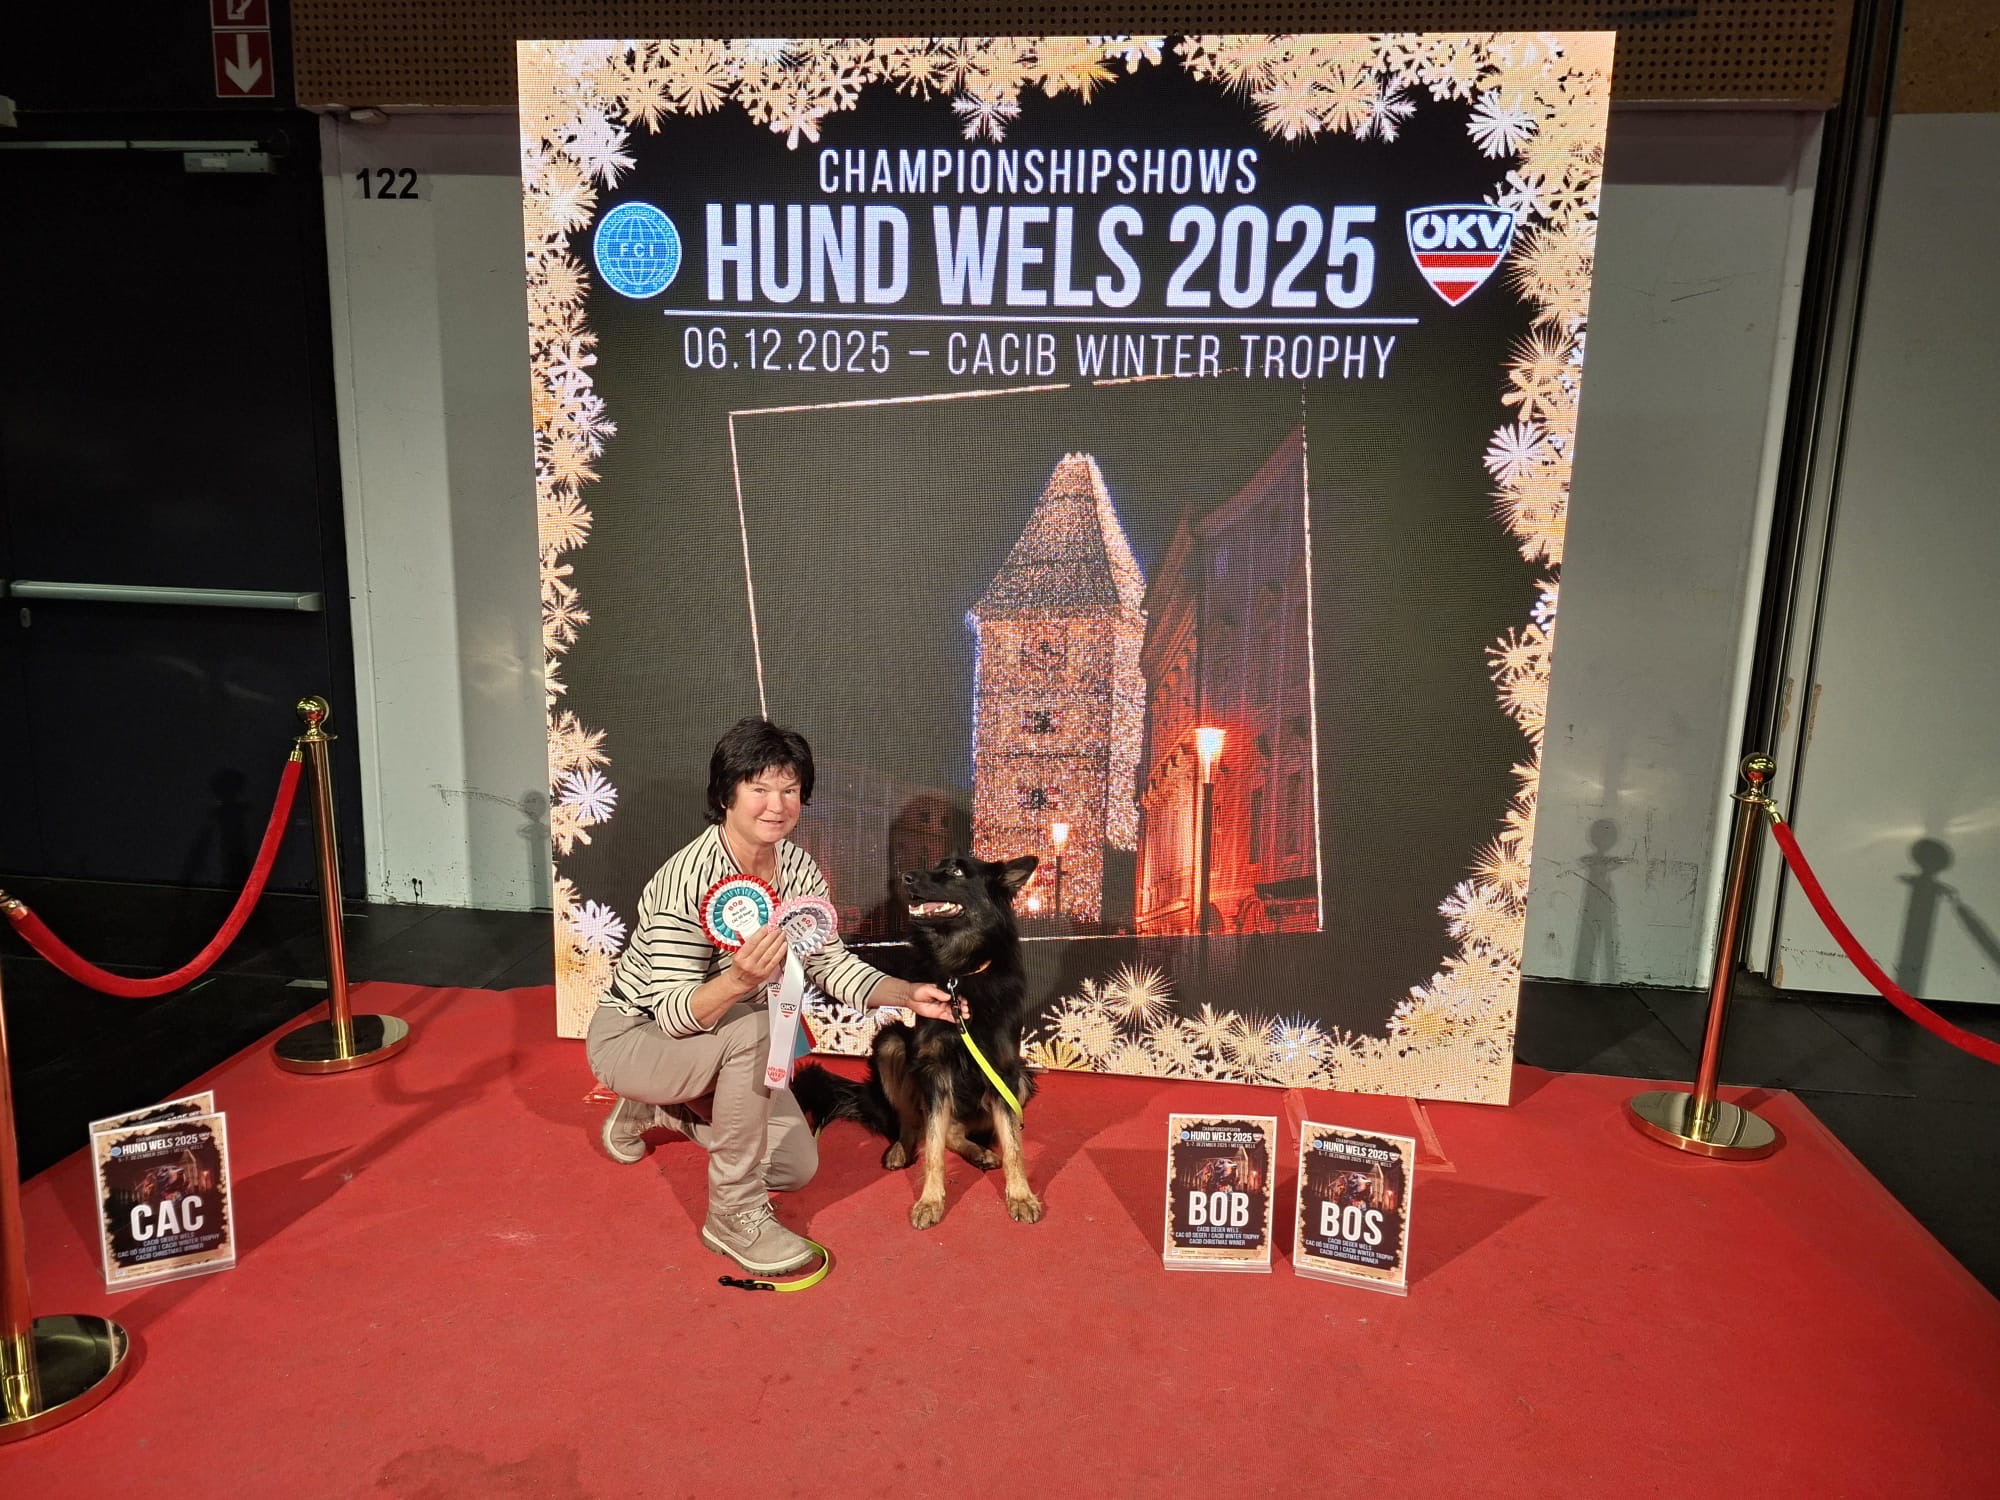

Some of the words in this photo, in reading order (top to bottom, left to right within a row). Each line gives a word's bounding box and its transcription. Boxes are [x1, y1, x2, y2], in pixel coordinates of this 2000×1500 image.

[356, 168, 419, 200] 122
[819, 148, 1259, 196] CHAMPIONSHIPSHOWS
[620, 242, 654, 257] FCI
[705, 203, 909, 304] HUND
[932, 204, 1143, 309] WELS
[1166, 204, 1377, 309] 2025
[683, 326, 890, 374] 06.12.2025
[947, 331, 1056, 376] CACIB
[1075, 334, 1220, 379] WINTER
[1240, 334, 1397, 379] TROPHY
[122, 1141, 147, 1155] HUND
[148, 1137, 173, 1150] WELS
[174, 1133, 198, 1147] 2025
[1190, 1131, 1210, 1141] HUND
[1211, 1132, 1232, 1141] WELS
[1232, 1133, 1252, 1142] 2025
[1322, 1141, 1345, 1153] HUND
[1345, 1144, 1367, 1157] WELS
[1367, 1148, 1389, 1161] 2025
[130, 1195, 204, 1242] CAC
[1188, 1190, 1249, 1227] BOB
[1320, 1200, 1384, 1246] BOS
